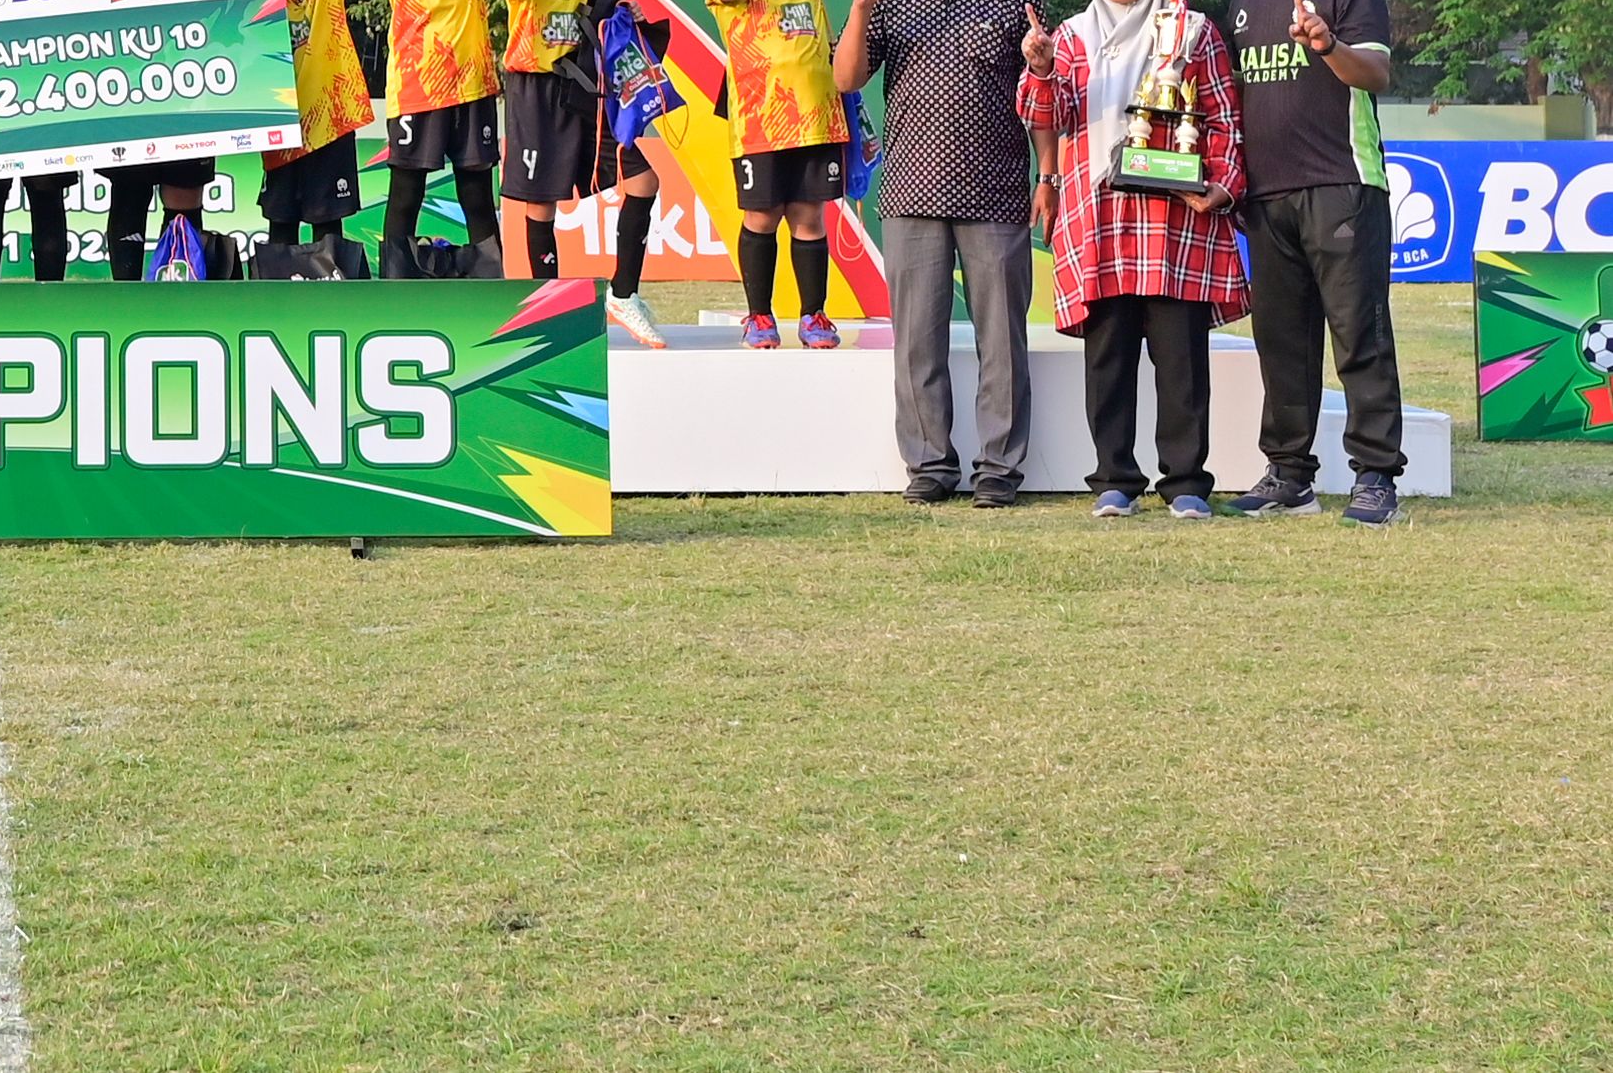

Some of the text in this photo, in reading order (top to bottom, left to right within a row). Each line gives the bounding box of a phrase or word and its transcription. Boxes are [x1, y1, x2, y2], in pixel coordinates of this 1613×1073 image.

[119, 25, 163, 60] KU
[169, 22, 207, 51] 10
[1243, 67, 1299, 84] CADEMY
[398, 115, 413, 145] 5
[741, 159, 754, 190] 3
[1403, 248, 1429, 264] BCA
